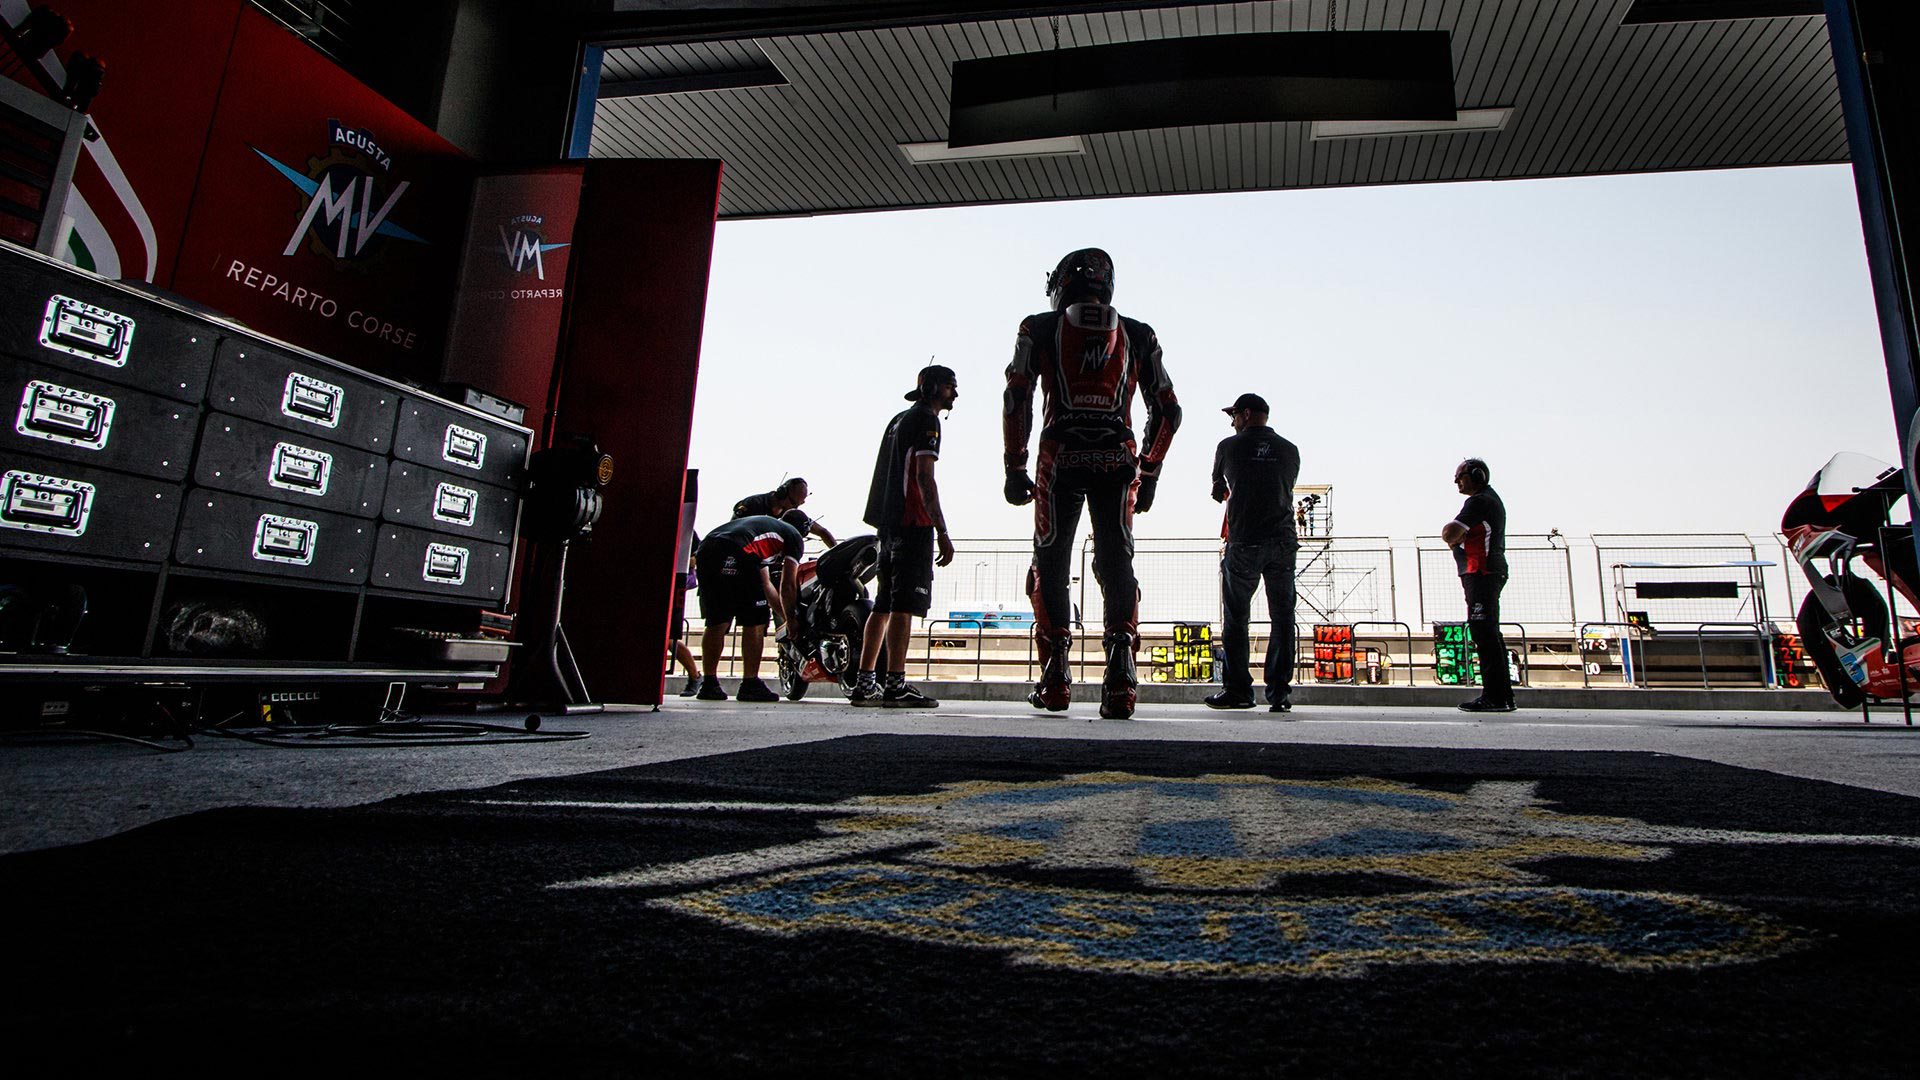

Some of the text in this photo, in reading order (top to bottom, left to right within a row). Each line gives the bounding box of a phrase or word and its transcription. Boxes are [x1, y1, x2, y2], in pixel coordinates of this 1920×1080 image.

[335, 127, 392, 171] AGUSTA
[283, 172, 412, 258] MV
[226, 259, 418, 351] REPARTO CORSE
[1073, 394, 1112, 406] MOTUL
